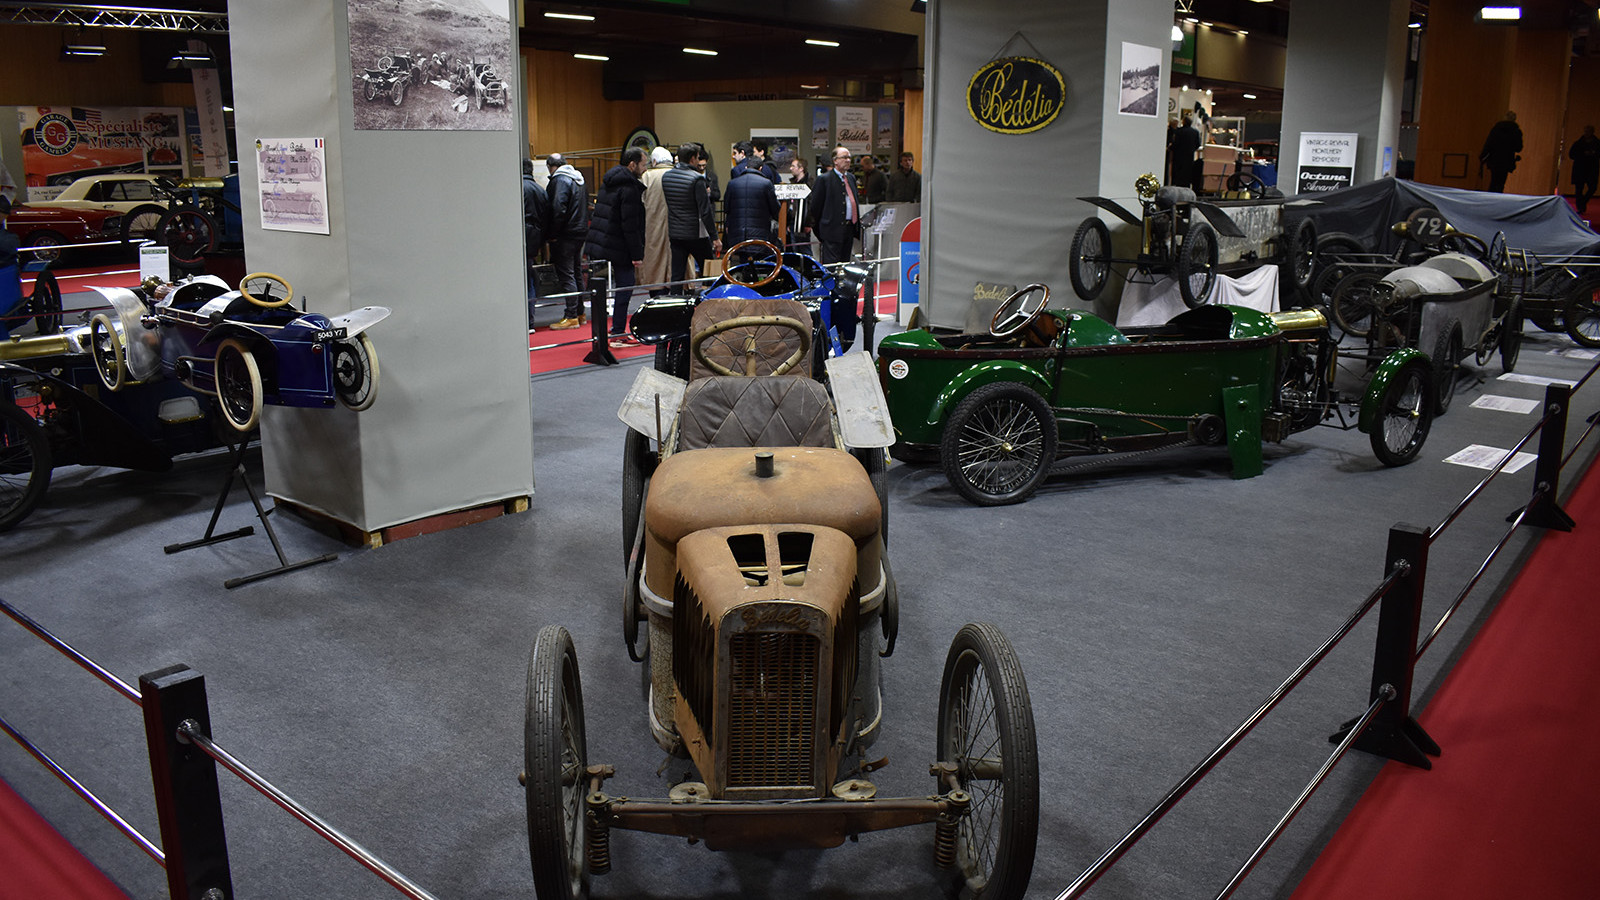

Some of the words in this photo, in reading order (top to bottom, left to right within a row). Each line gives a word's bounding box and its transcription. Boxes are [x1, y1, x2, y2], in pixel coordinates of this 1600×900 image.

[980, 62, 1054, 127] Bédélia
[40, 114, 70, 124] GARAGE
[86, 119, 162, 136] Spécialiste
[39, 140, 76, 155] GAMBETTA
[89, 137, 163, 149] MUSTANG
[1300, 171, 1349, 181] Octane
[1416, 217, 1441, 236] 72
